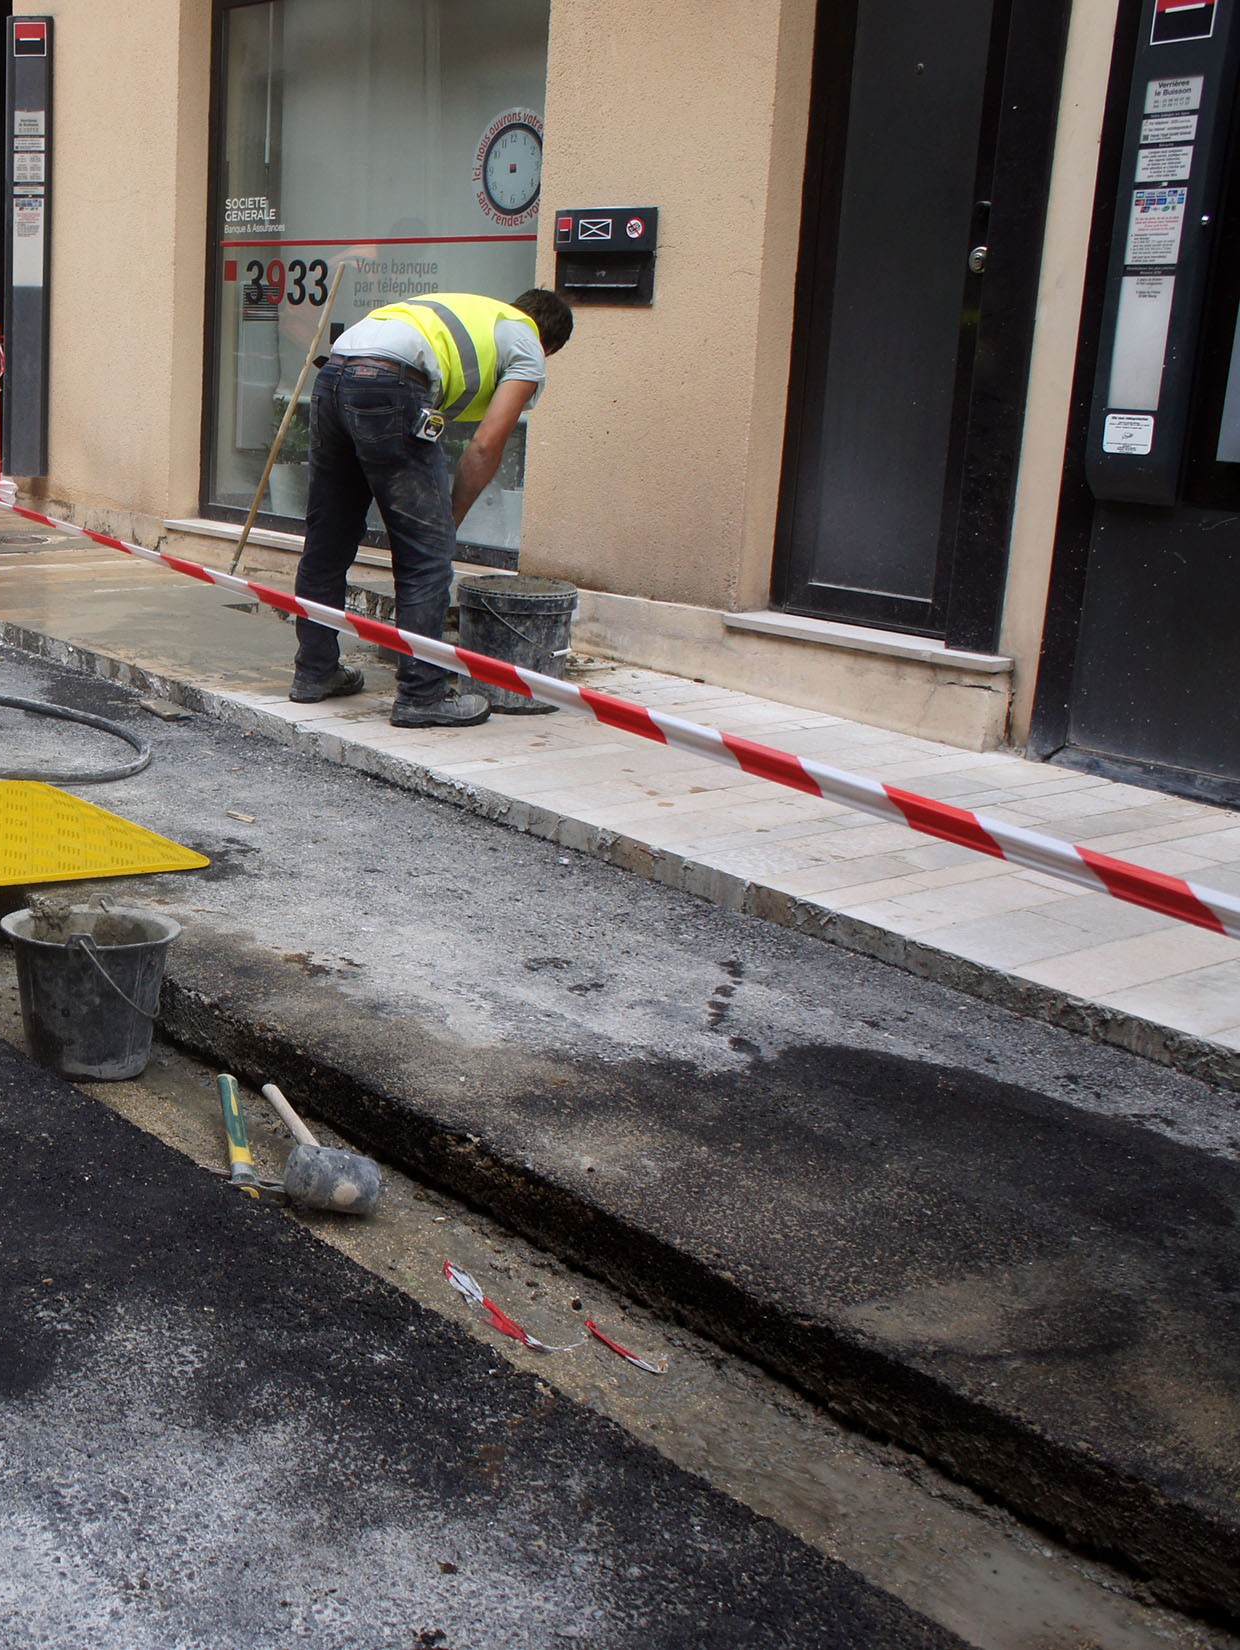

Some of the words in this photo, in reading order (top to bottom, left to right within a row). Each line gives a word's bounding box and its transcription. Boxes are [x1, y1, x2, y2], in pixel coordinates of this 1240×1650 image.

[476, 133, 491, 161] nous
[489, 112, 522, 136] ouvrons
[523, 112, 544, 132] votre
[225, 197, 267, 210] SOCIETE
[476, 191, 492, 216] sans
[224, 208, 277, 222] GENERALE
[224, 224, 246, 234] Banque
[247, 223, 252, 233] &
[252, 223, 286, 233] Assurances
[356, 259, 388, 274] Votre
[391, 259, 439, 278] banque
[246, 259, 329, 306] 3933
[354, 280, 374, 296] par
[377, 277, 439, 297] téléphone
